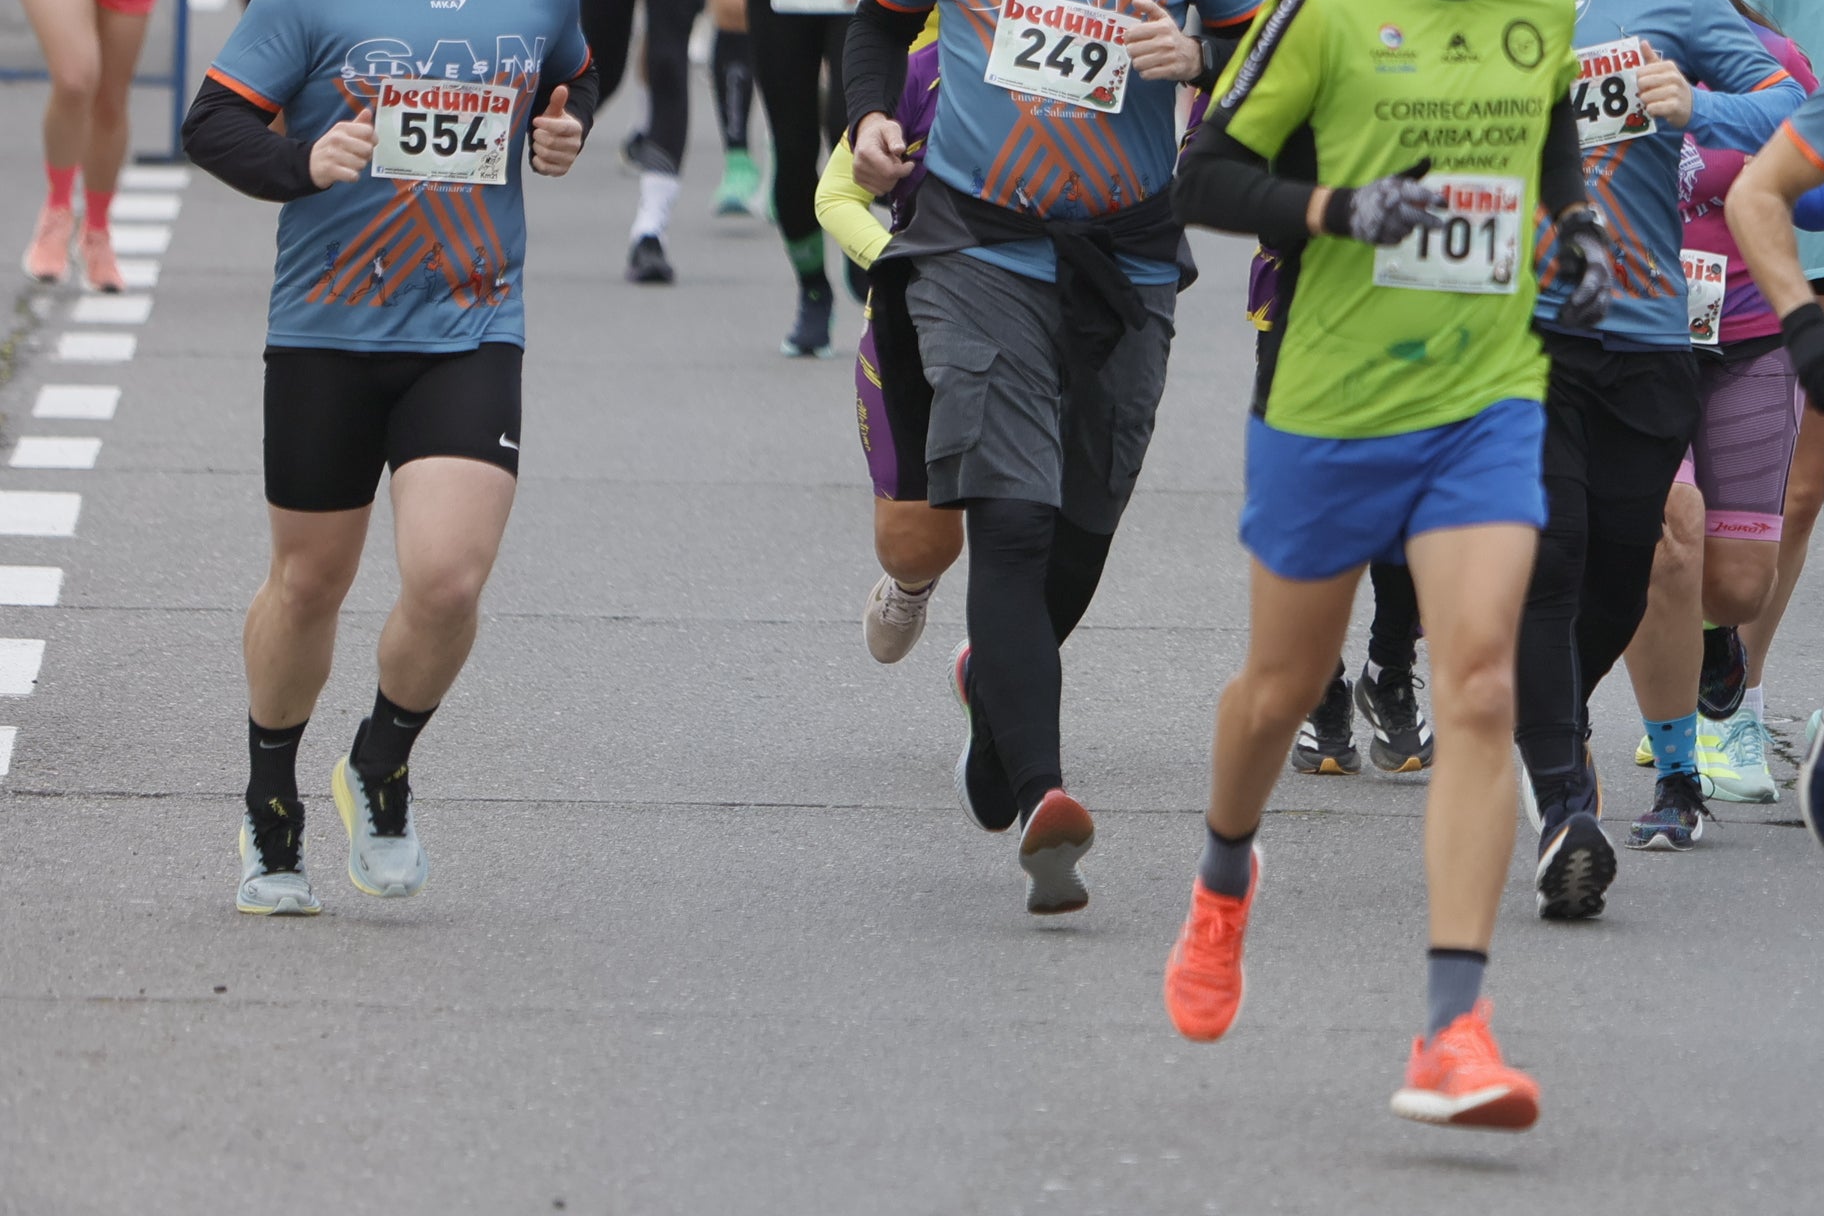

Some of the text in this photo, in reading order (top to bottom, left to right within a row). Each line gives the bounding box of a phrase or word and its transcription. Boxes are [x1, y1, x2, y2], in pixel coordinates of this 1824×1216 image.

[430, 0, 457, 10] MKA
[1013, 27, 1109, 84] 249
[381, 85, 511, 115] bedunia
[1043, 106, 1096, 119] Salamanca
[1374, 97, 1544, 121] CORRECAMINOS
[400, 111, 488, 159] 554
[1399, 125, 1527, 149] CARBAJOSA
[1417, 216, 1498, 263] 101
